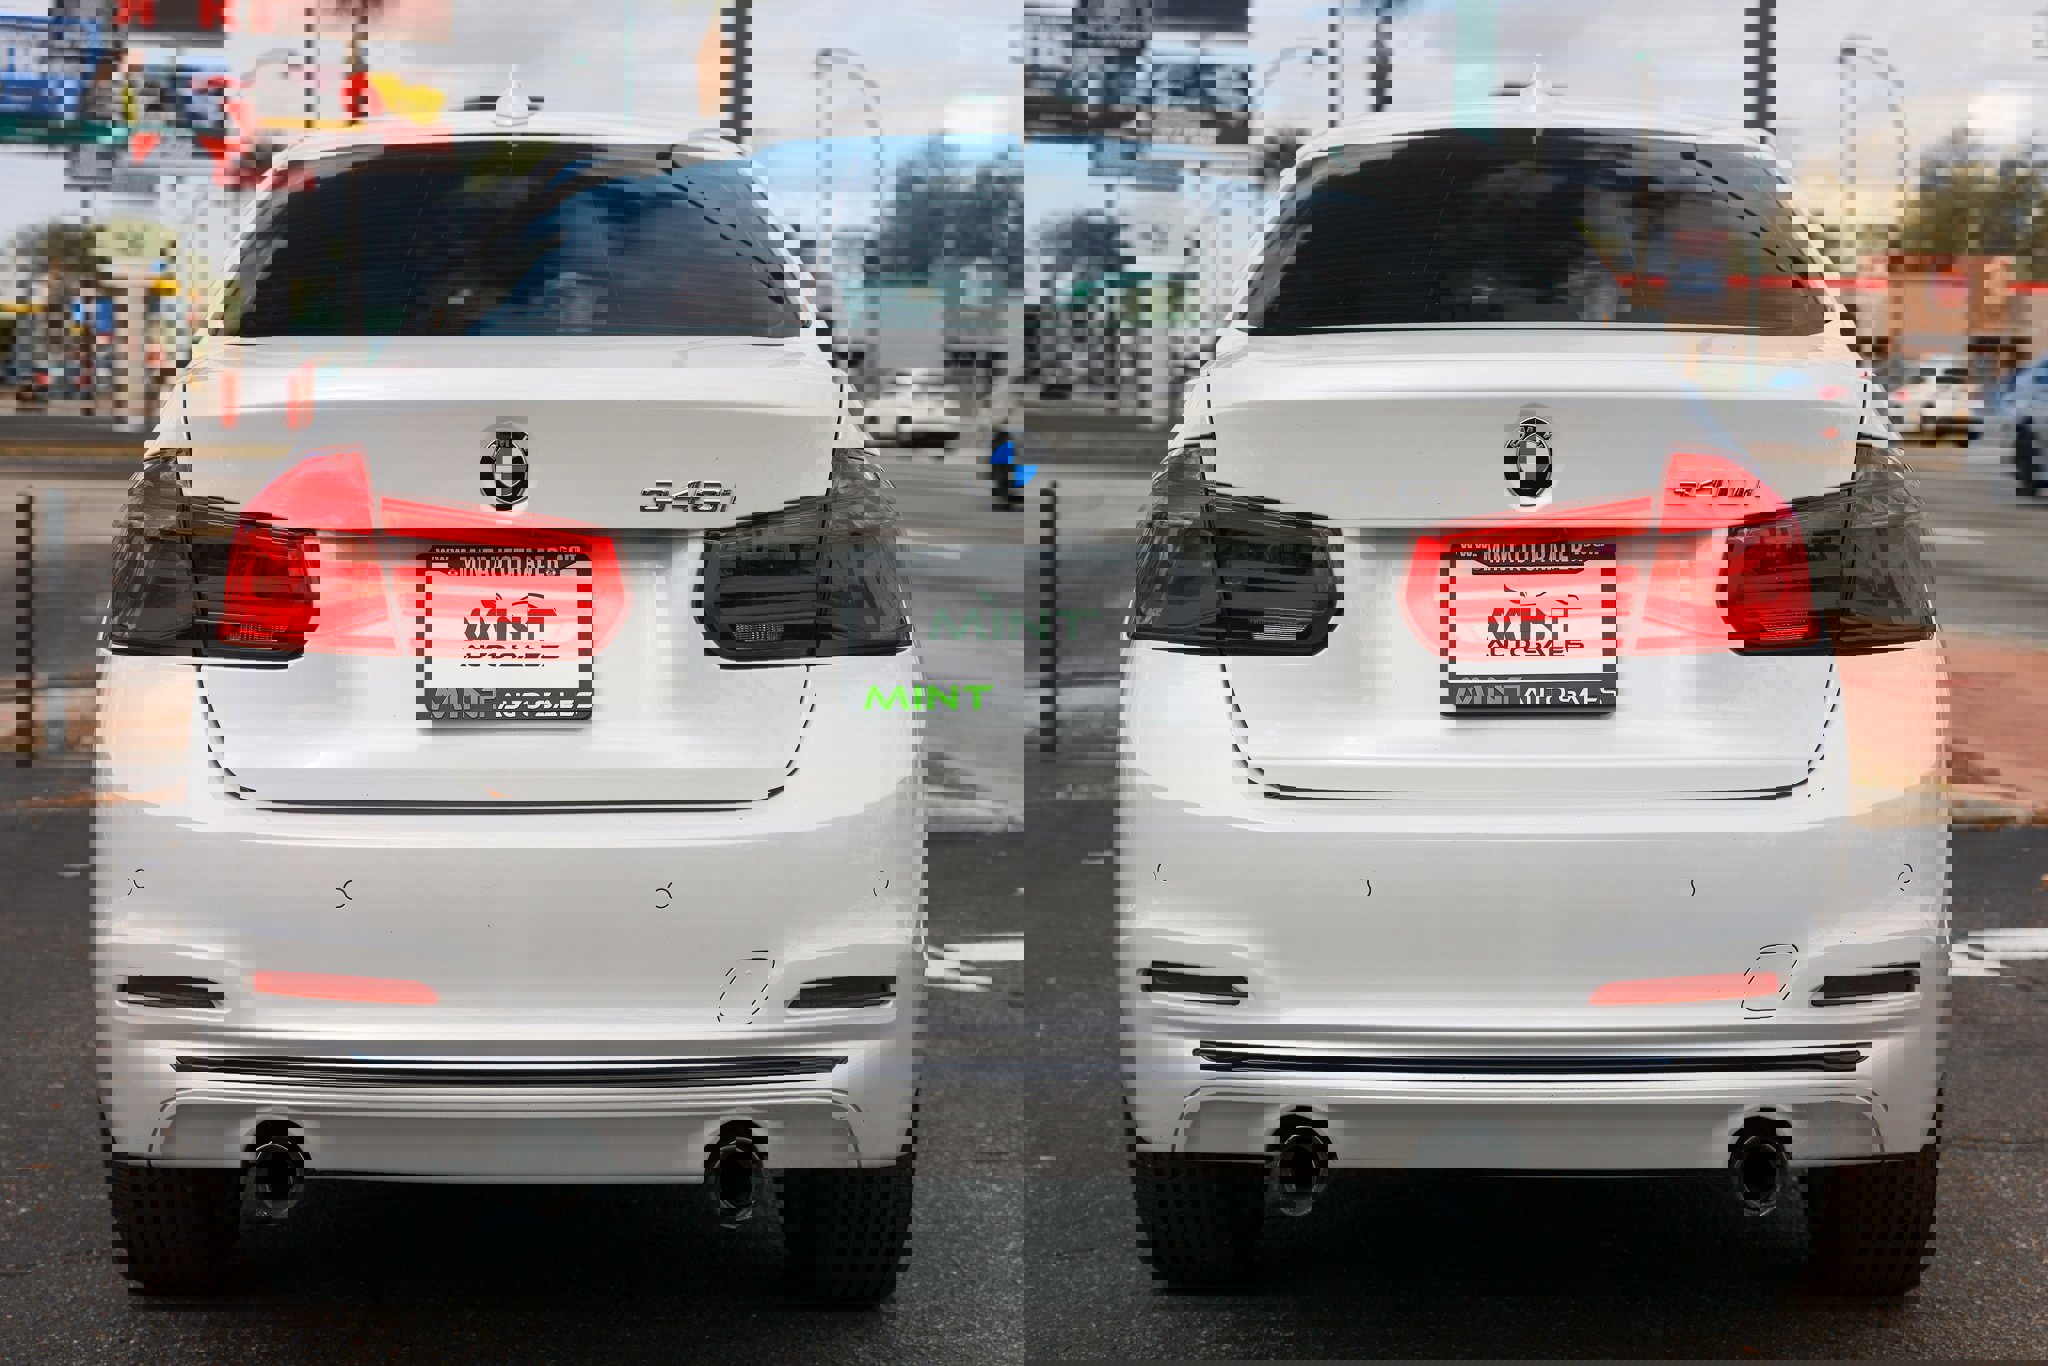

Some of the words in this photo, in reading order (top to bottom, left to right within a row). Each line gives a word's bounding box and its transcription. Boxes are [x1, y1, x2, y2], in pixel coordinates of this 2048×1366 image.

[981, 426, 1048, 453] BMW
[1294, 479, 1469, 505] 340i
[926, 607, 1103, 642] MINT
[924, 644, 1003, 659] AUTO
[1011, 644, 1105, 659] SALES
[862, 684, 995, 711] MINT
[993, 692, 1071, 710] AUTO
[1078, 690, 1171, 710] SALES
